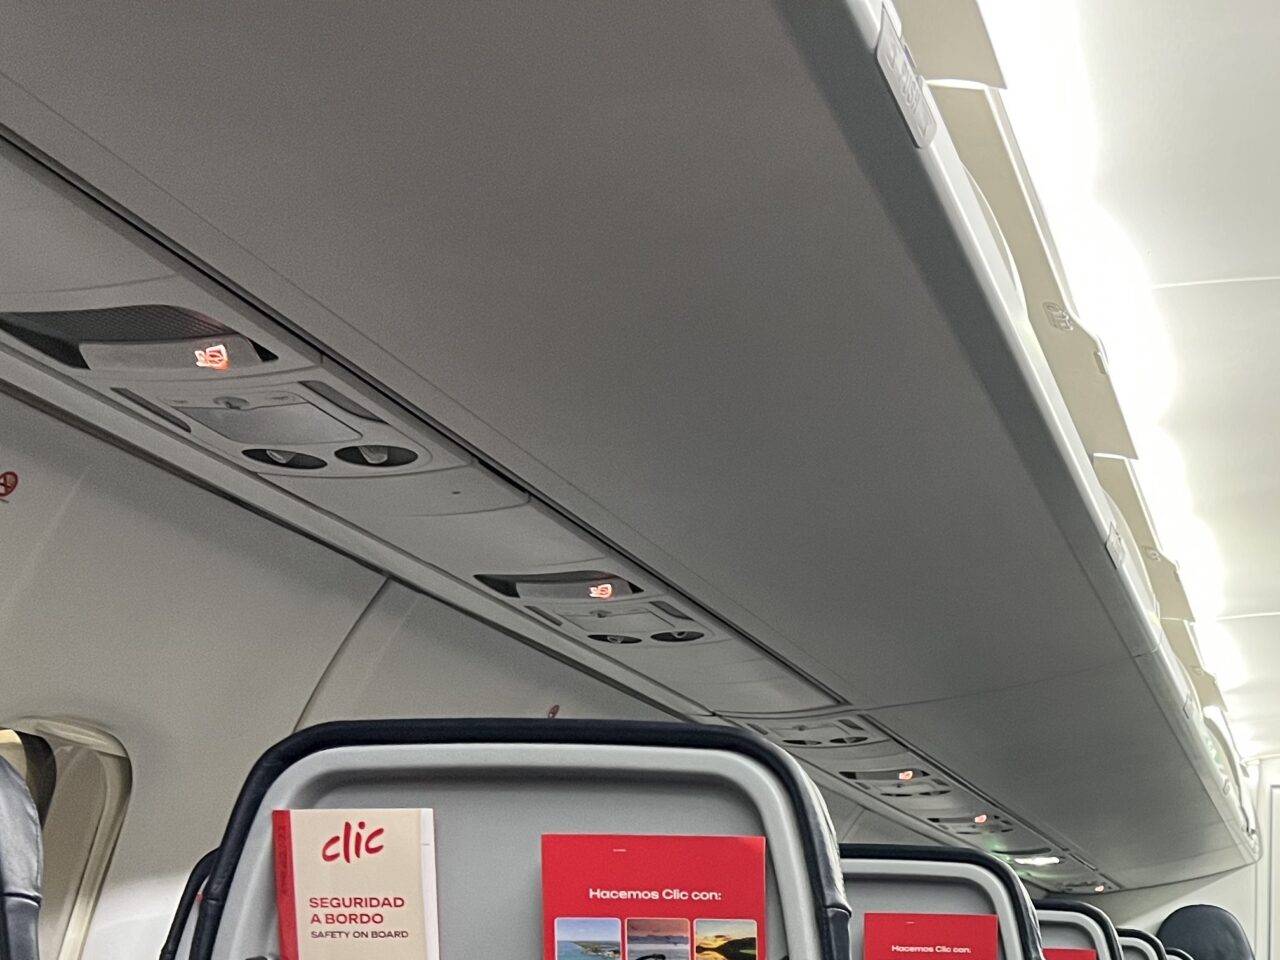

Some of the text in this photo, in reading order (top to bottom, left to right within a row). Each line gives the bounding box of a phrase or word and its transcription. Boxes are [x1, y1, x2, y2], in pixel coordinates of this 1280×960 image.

[322, 821, 385, 864] clic
[589, 888, 722, 901] Hacemos Clic con:
[309, 897, 405, 908] SEGURIDAD
[310, 913, 384, 925] A BORDO
[311, 930, 409, 939] SAFETY ON BOARD
[891, 945, 934, 953] Hacemos
